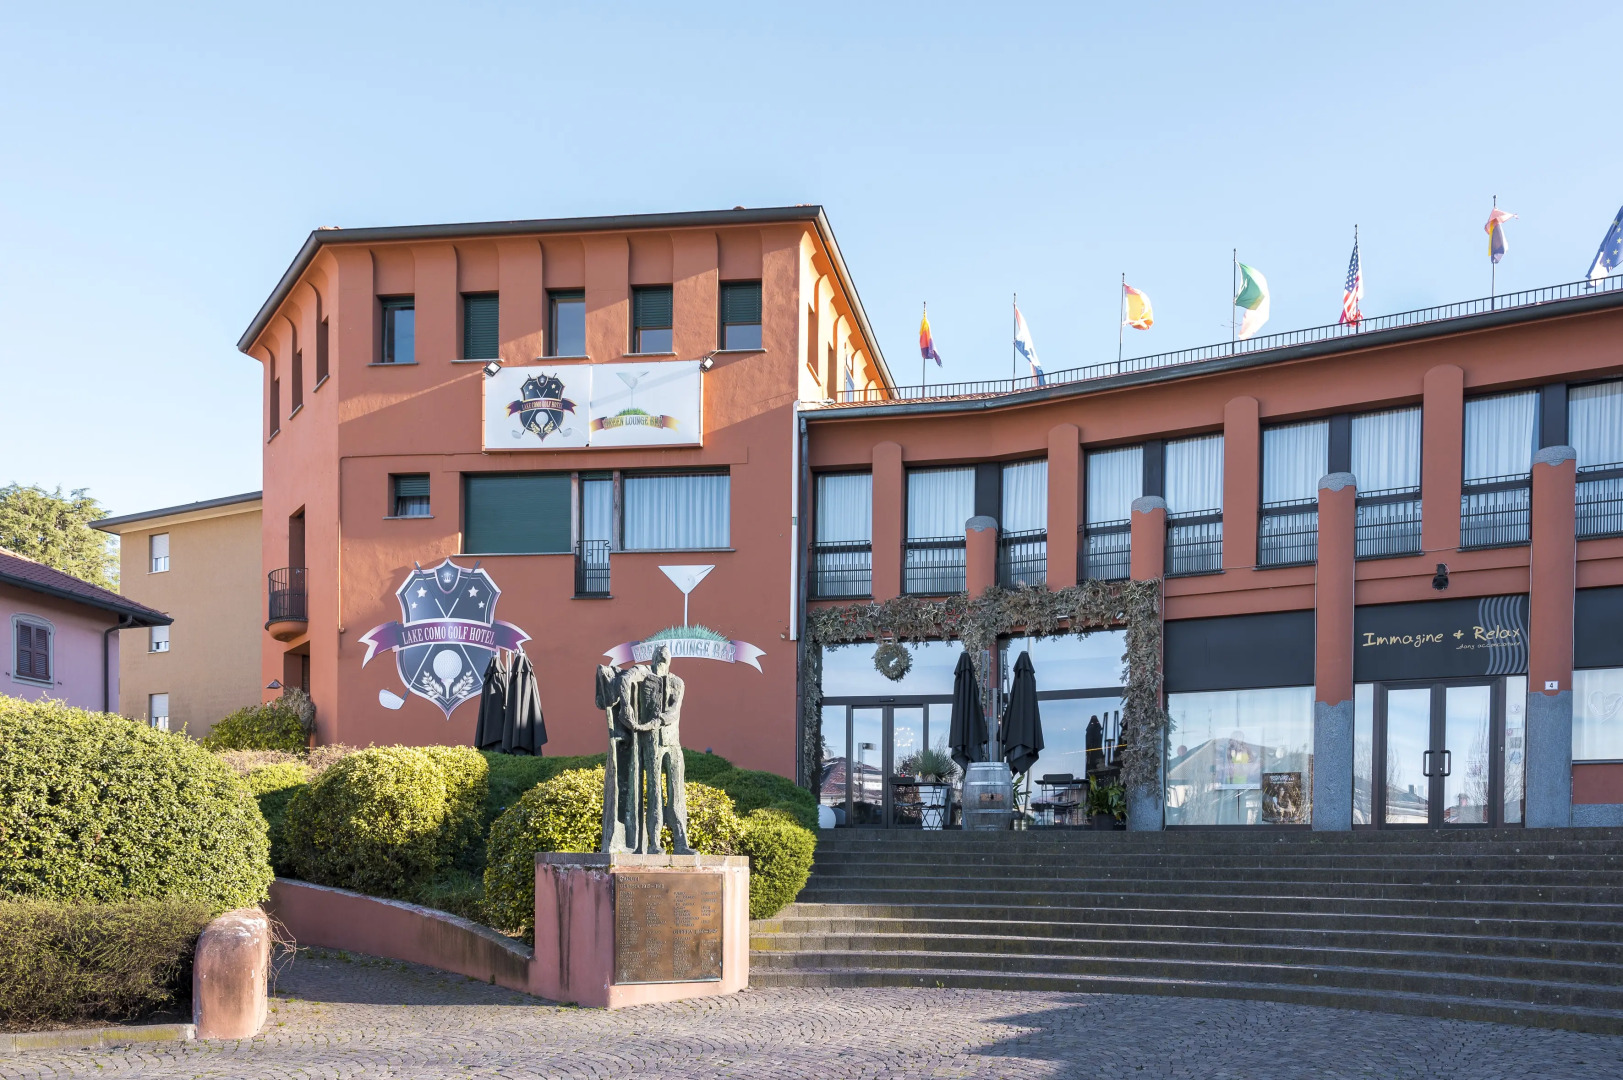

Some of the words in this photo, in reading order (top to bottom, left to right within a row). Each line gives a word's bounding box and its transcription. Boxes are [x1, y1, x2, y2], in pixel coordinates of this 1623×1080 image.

[625, 416, 649, 426] LOUNGE
[402, 628, 424, 645] LAKE
[424, 626, 446, 641] COMO
[447, 625, 469, 640] GOLF
[469, 627, 495, 645] HOTEL
[1362, 632, 1444, 648] Immagine
[1472, 624, 1520, 641] Relax
[669, 639, 711, 656] LOUNGE
[712, 642, 736, 662] BAR
